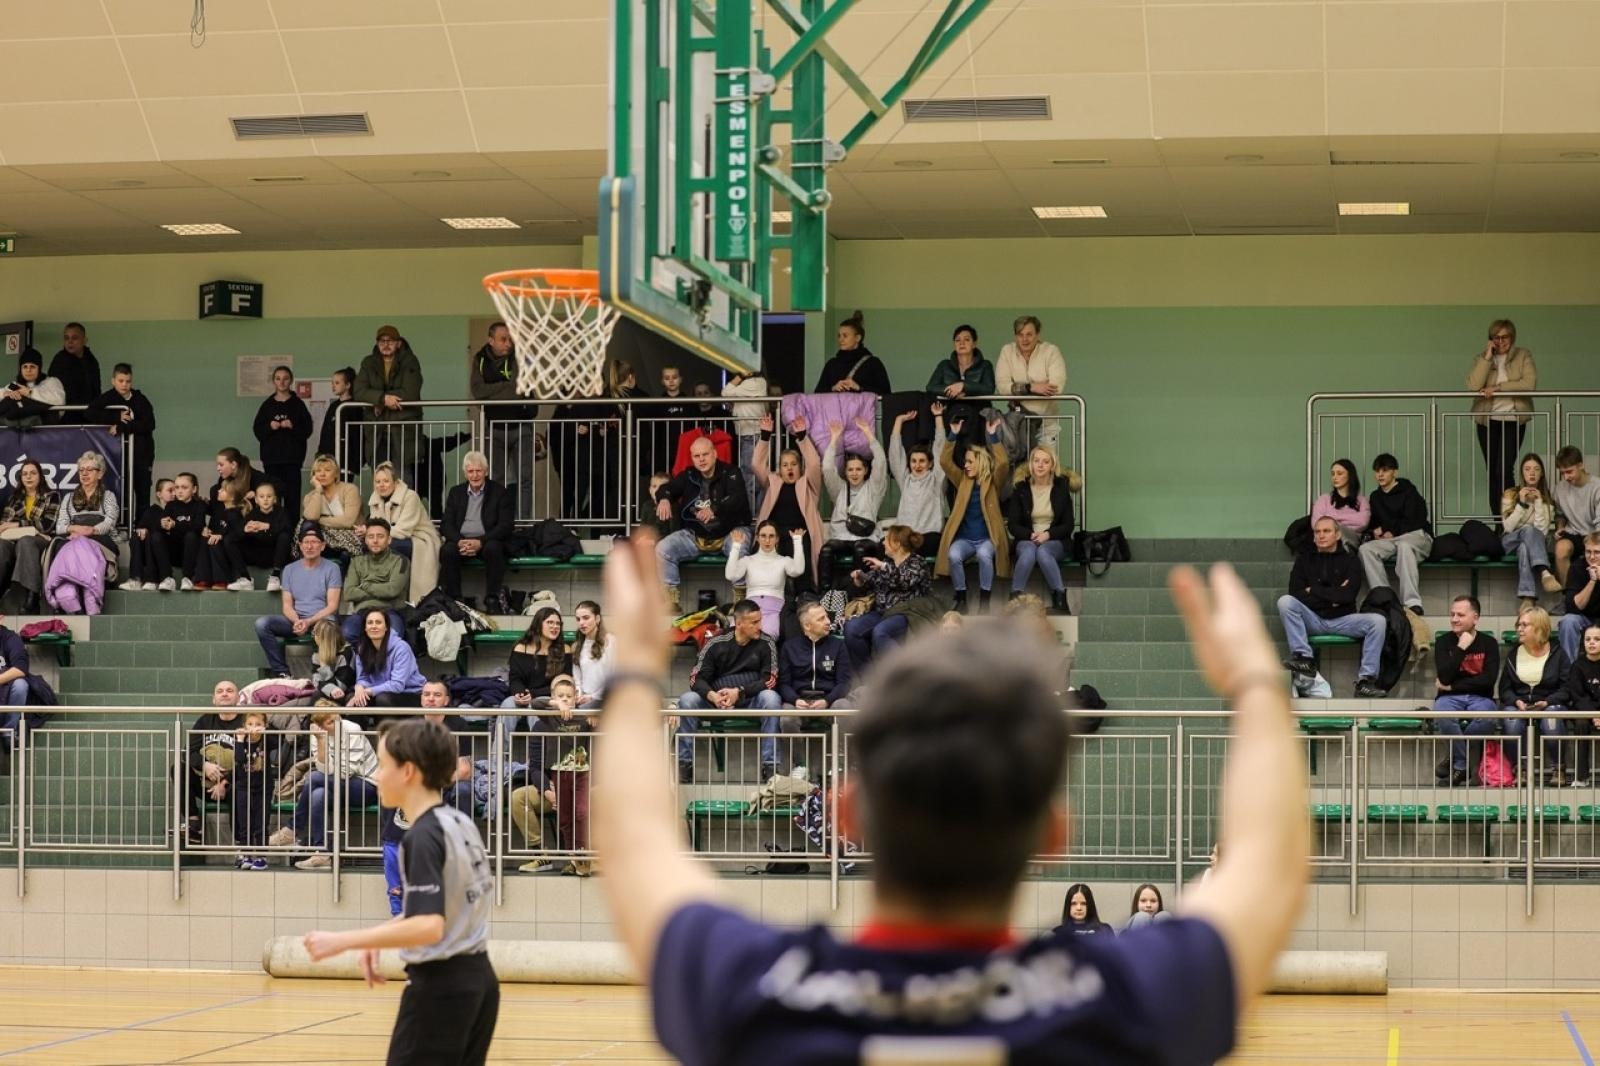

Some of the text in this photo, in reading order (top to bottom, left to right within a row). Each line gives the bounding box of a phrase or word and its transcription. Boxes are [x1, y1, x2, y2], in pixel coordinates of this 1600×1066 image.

[227, 283, 255, 292] SEKTOR
[204, 293, 214, 315] F
[231, 293, 251, 313] F
